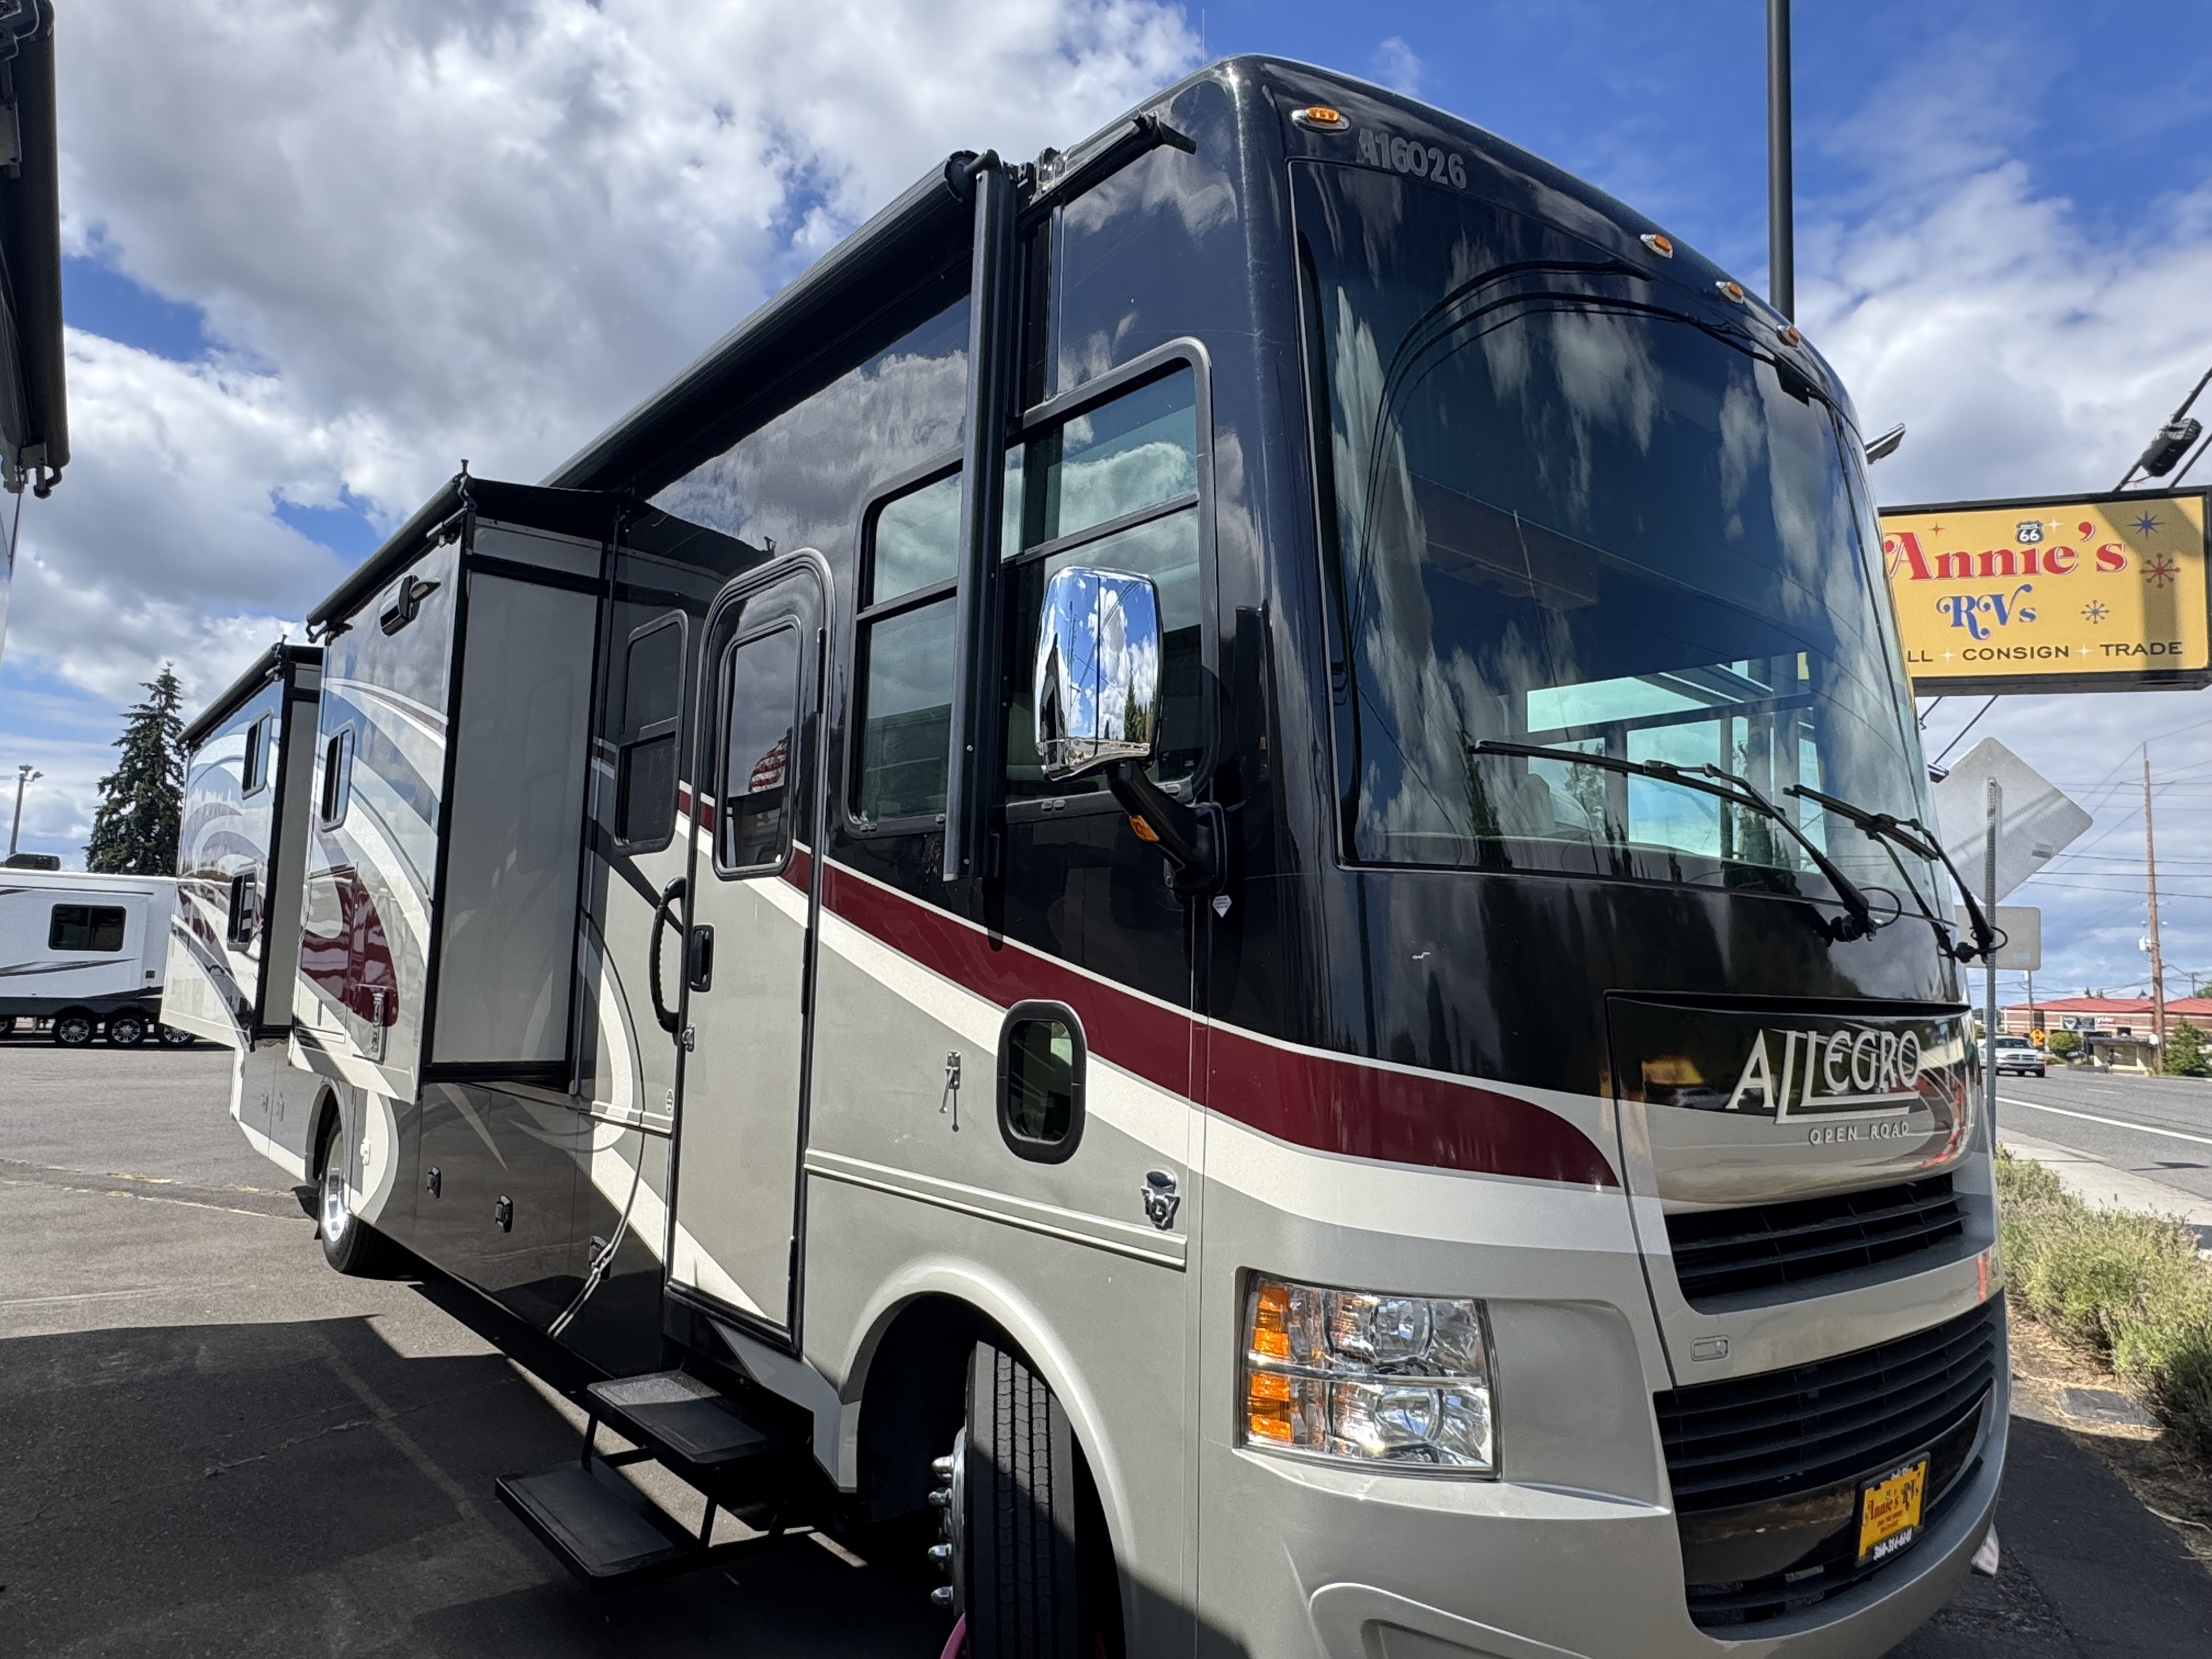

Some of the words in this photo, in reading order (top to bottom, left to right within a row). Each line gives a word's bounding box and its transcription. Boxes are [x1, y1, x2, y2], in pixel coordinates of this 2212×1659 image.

[1356, 128, 1467, 189] A16026
[1882, 521, 2126, 580] Annie's
[2019, 529, 2040, 541] 66
[1936, 584, 2037, 640] RVs
[1907, 650, 1933, 663] LL
[1962, 646, 2069, 661] CONSIGN
[2100, 642, 2183, 657] TRADE
[1725, 1028, 1921, 1125] ALLEGRO
[1809, 1125, 1858, 1145] OPEN
[1870, 1120, 1909, 1139] ROAD
